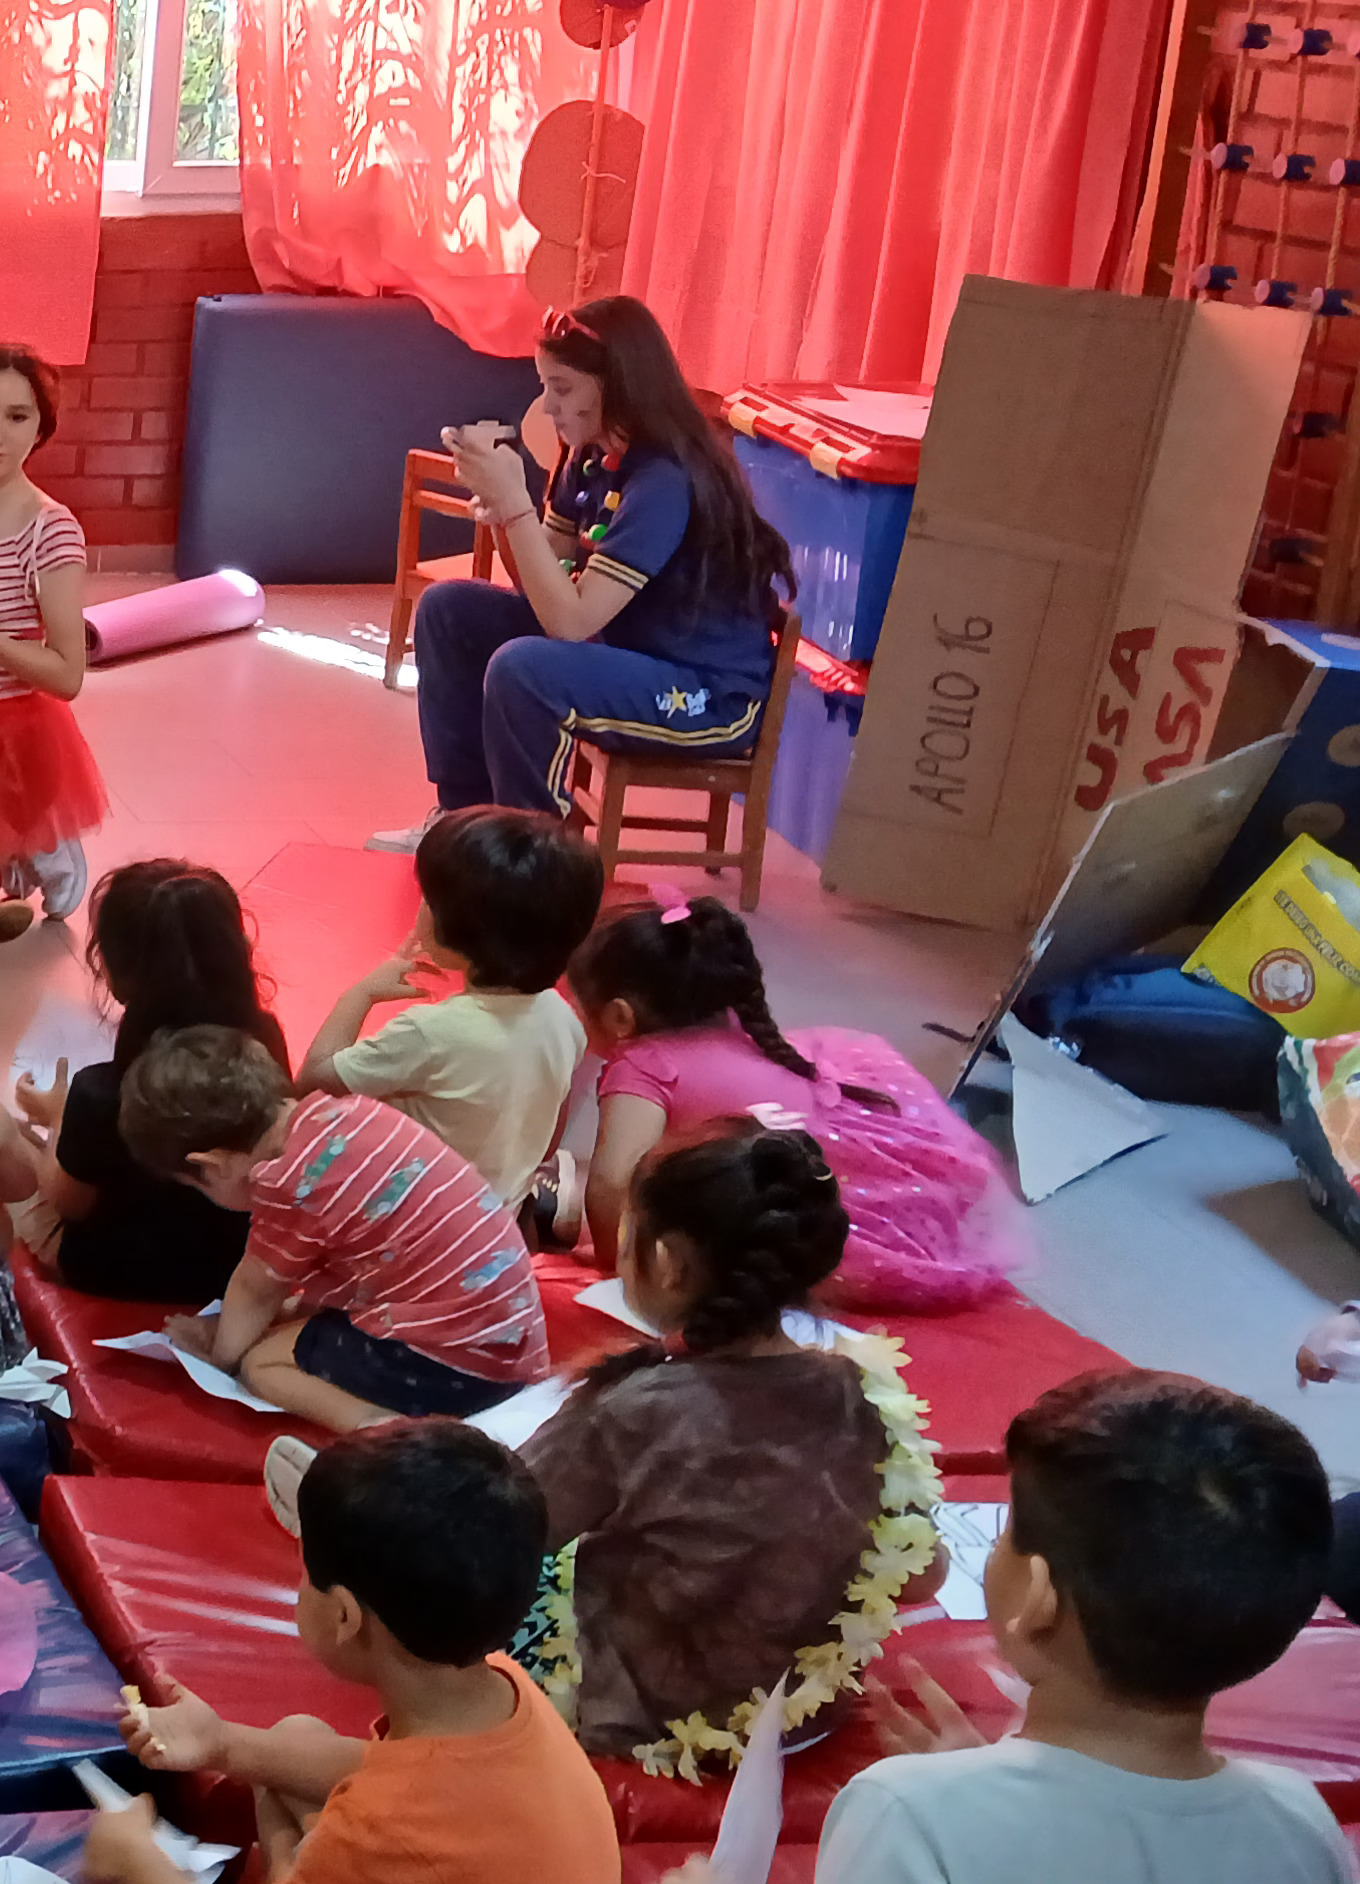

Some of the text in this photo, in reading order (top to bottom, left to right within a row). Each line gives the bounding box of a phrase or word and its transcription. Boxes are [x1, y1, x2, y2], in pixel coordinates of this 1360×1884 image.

[908, 612, 993, 815] APOLLO 16
[1074, 626, 1156, 812] USA
